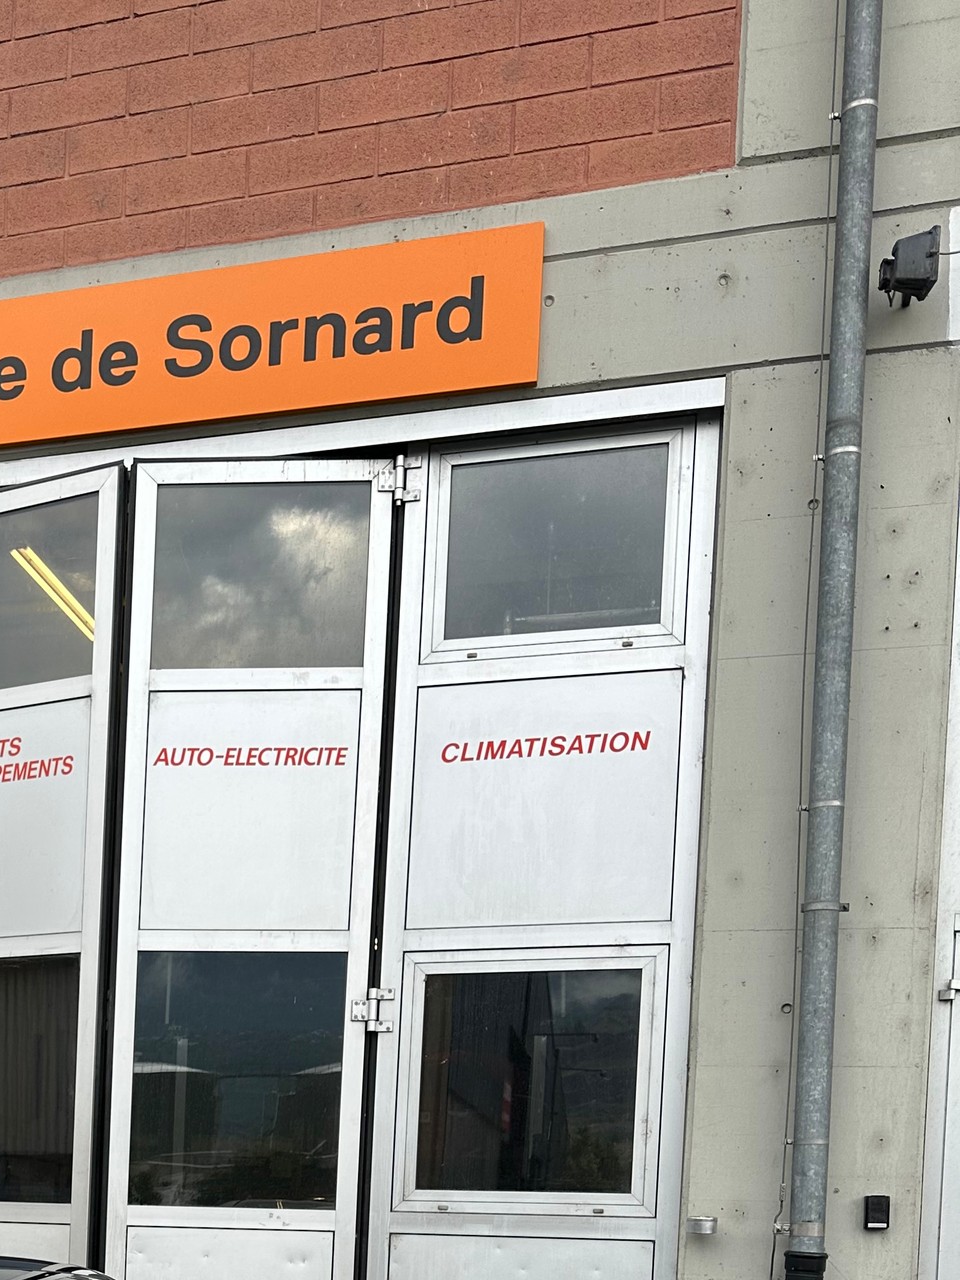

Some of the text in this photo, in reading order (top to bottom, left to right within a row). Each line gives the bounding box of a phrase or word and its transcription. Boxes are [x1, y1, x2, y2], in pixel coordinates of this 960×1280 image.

[50, 329, 139, 394] de
[163, 275, 486, 380] Sornard
[153, 746, 349, 767] AUTO-ELECTRICITE
[440, 730, 652, 764] CLIMATISATION
